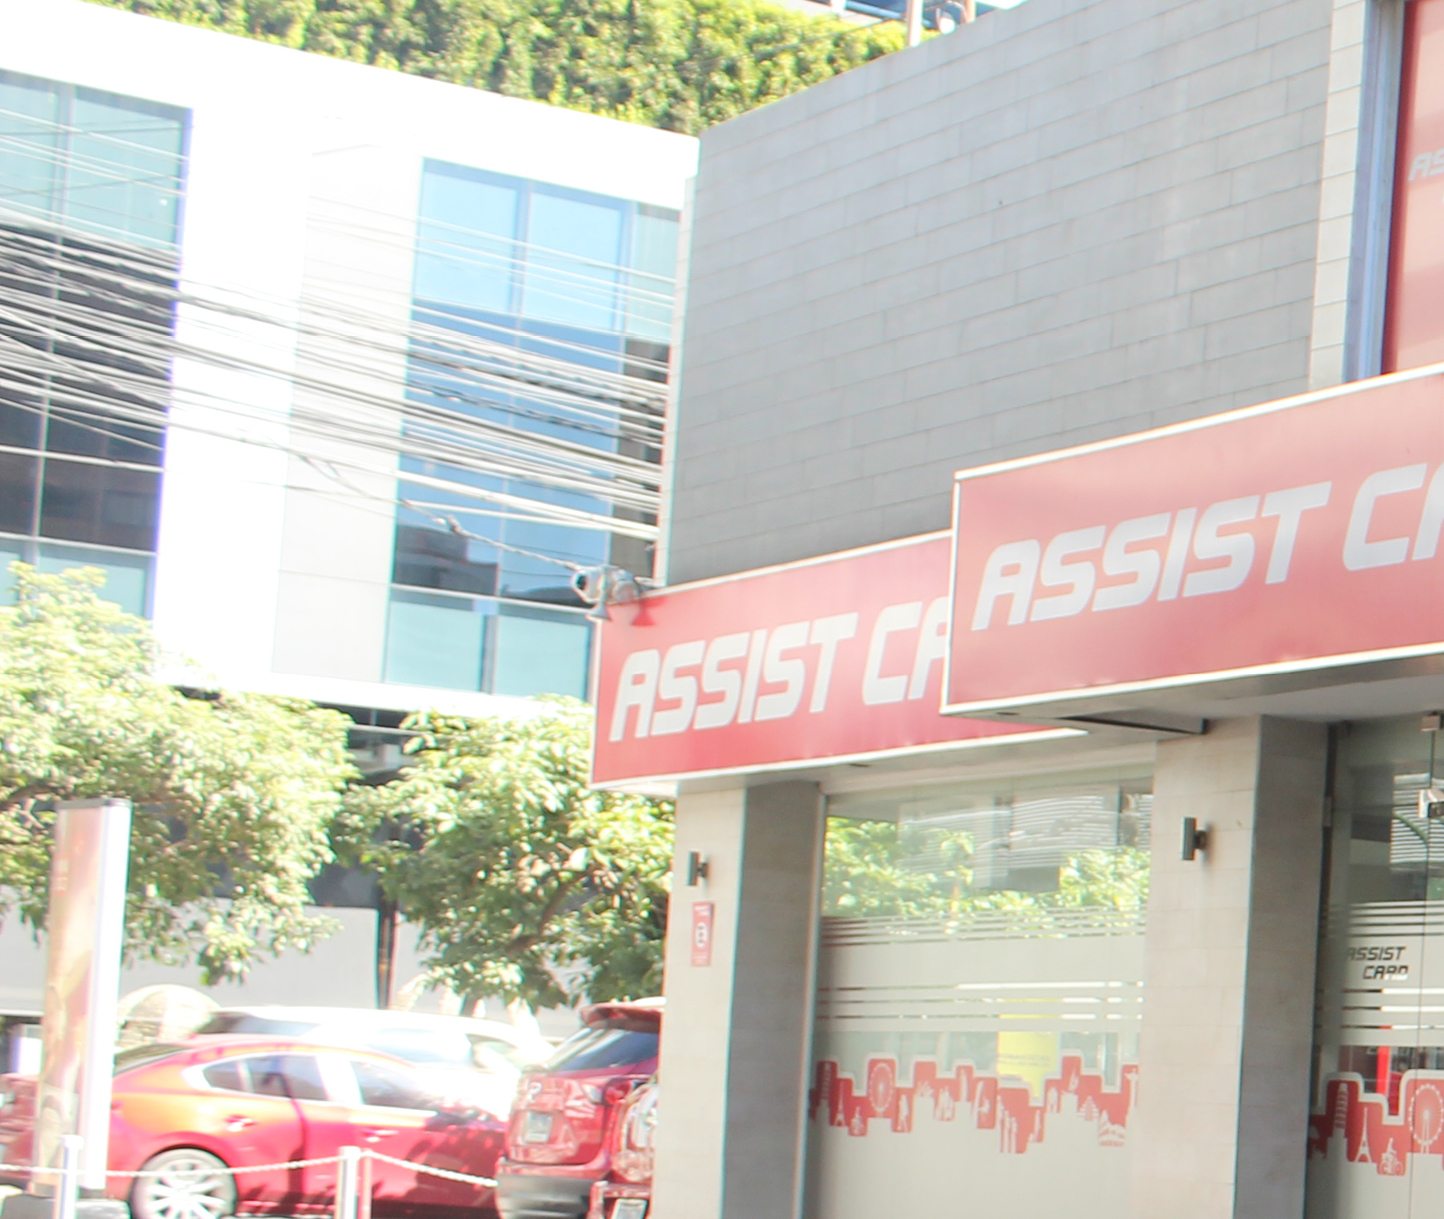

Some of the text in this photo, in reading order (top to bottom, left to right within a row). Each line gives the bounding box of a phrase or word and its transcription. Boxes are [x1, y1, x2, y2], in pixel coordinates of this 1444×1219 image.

[971, 481, 1332, 631] ASSIST
[608, 612, 859, 742] ASSIST
[1345, 946, 1407, 961] ASSIST
[1363, 965, 1409, 980] CARD
